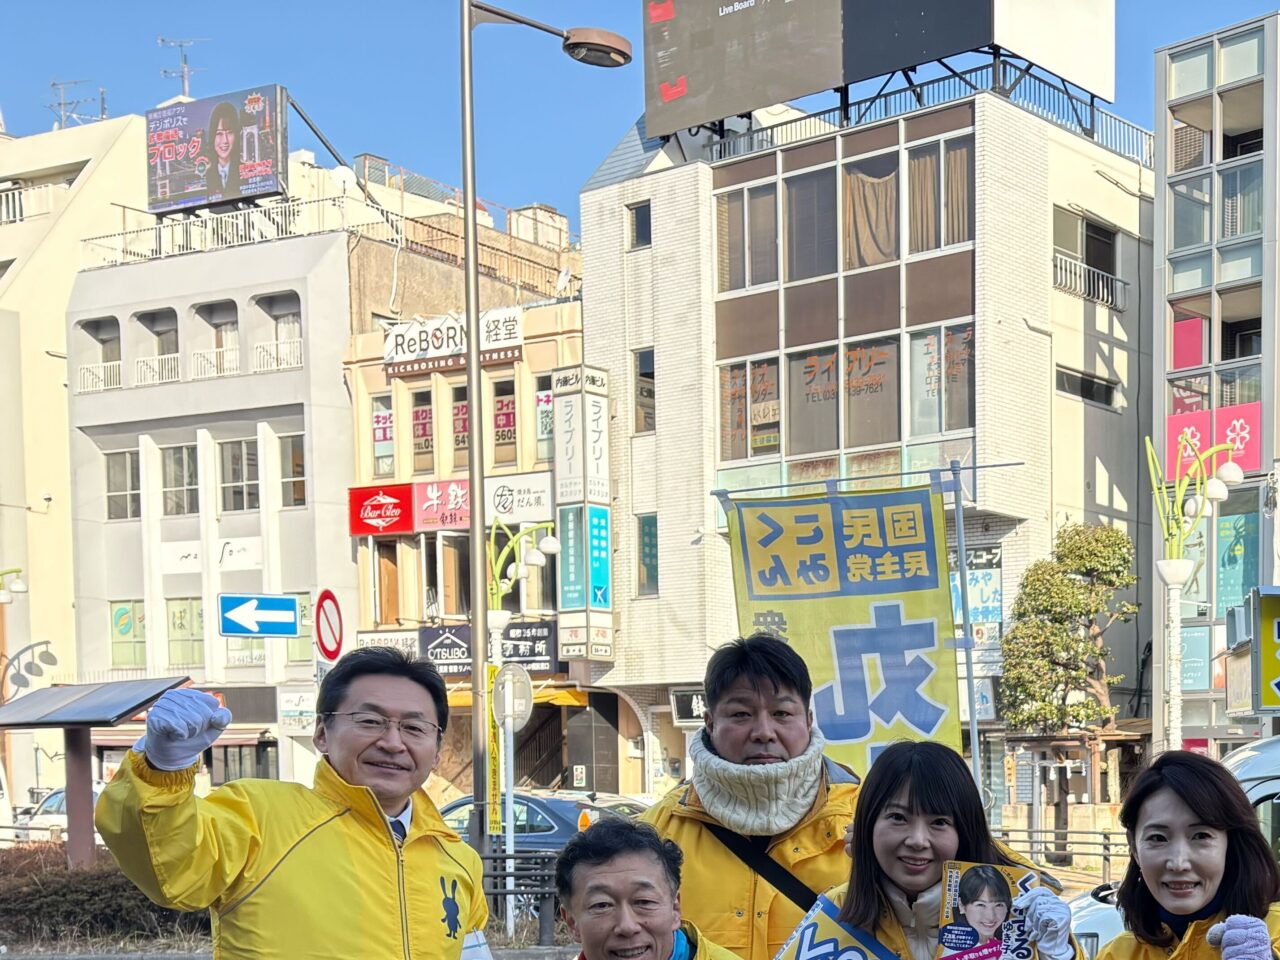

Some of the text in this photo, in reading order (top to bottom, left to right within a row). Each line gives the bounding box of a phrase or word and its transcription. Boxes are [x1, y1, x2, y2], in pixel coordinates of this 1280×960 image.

[718, 0, 755, 16] Live Board
[149, 137, 202, 165] ブロック
[485, 316, 519, 343] 経堂
[387, 360, 454, 374] KICKBOXING
[480, 350, 520, 361] ITNESS
[564, 400, 575, 475] ライブリー
[592, 400, 603, 475] ライブリー
[360, 505, 381, 518] Bar
[969, 571, 992, 588] みや
[980, 587, 1001, 604] した
[427, 647, 468, 660] OTSUBO
[1002, 921, 1014, 955] ゆき子
